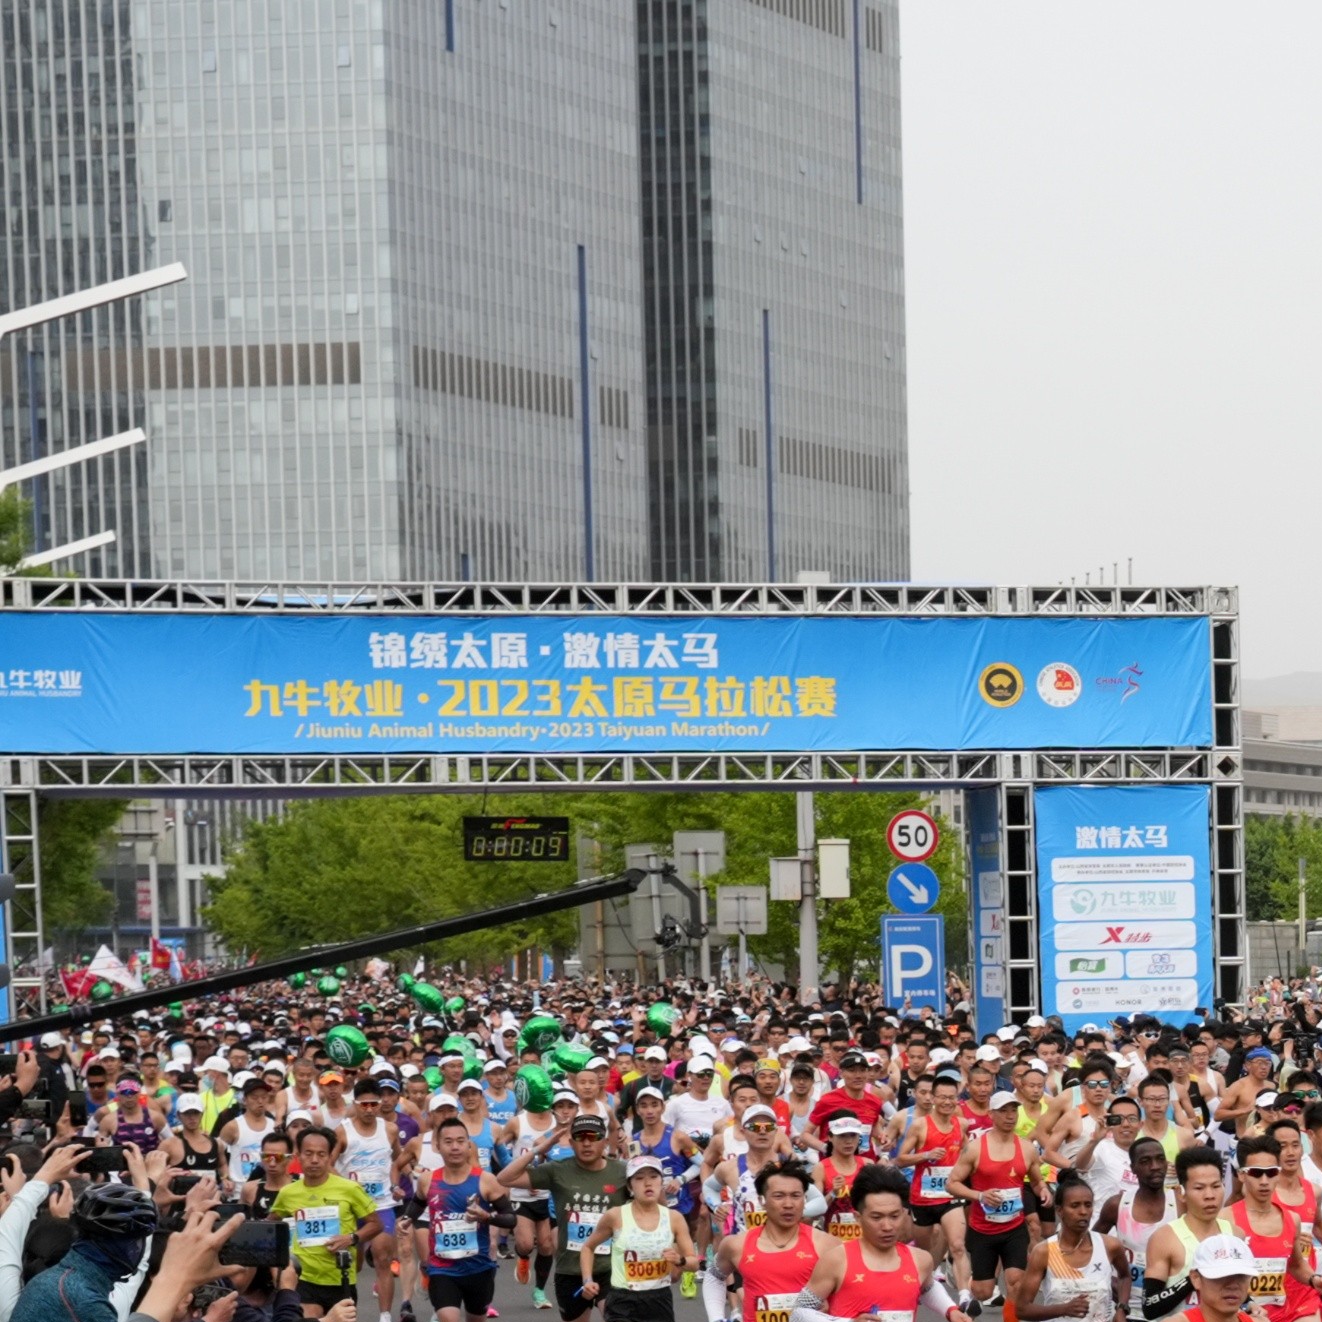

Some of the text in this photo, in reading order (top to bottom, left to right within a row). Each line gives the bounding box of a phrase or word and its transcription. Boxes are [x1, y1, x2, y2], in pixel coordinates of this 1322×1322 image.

[368, 722, 433, 738] Animal
[599, 721, 667, 741] Taiyuan
[897, 825, 928, 847] 50
[1075, 825, 1169, 850] 激情太马
[1100, 890, 1177, 907] 九牛牧业
[890, 944, 933, 998] P
[304, 1220, 327, 1235] 381
[442, 1232, 467, 1247] 638
